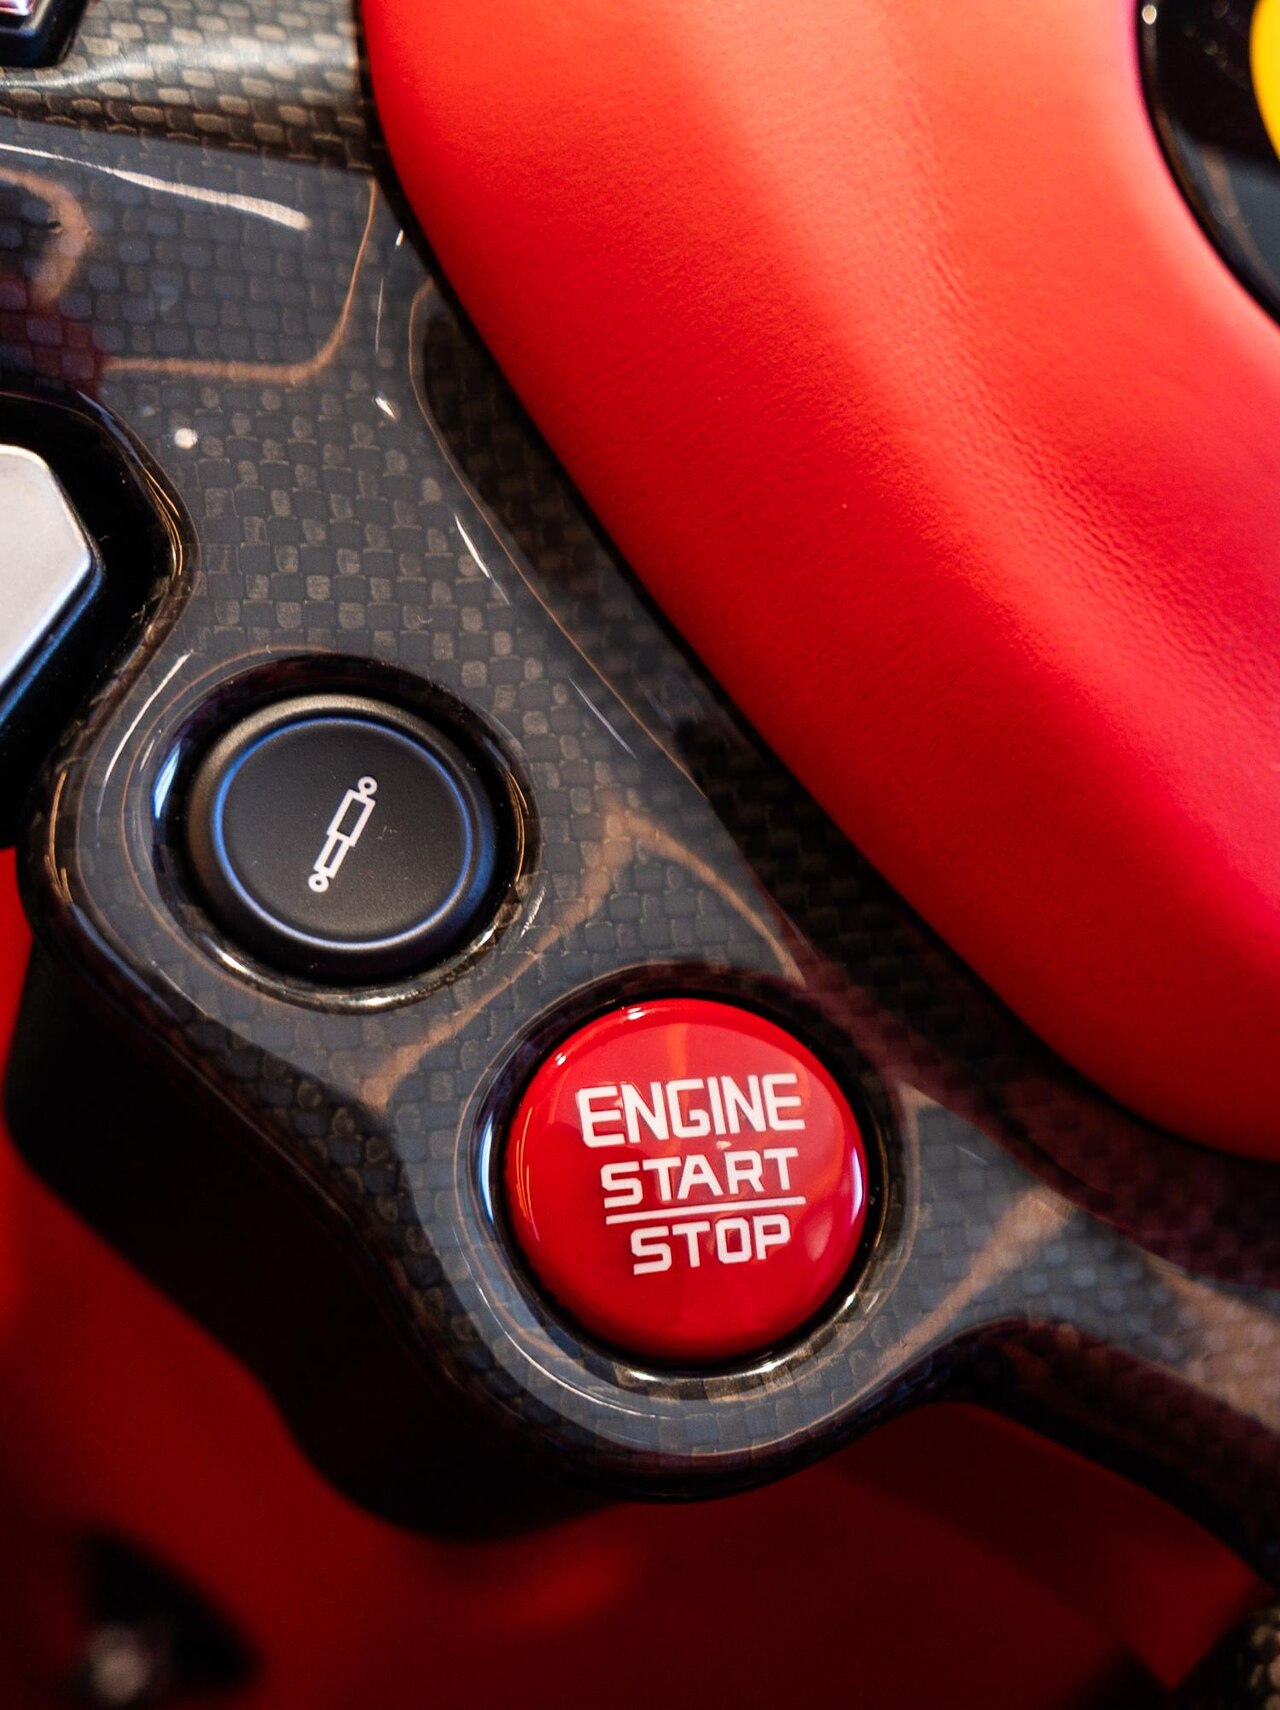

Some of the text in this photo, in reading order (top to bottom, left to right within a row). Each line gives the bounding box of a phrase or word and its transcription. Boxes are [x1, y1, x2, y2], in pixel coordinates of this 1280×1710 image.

[576, 1073, 806, 1148] ENGINE
[600, 1147, 799, 1209] START
[630, 1213, 791, 1275] STOP
